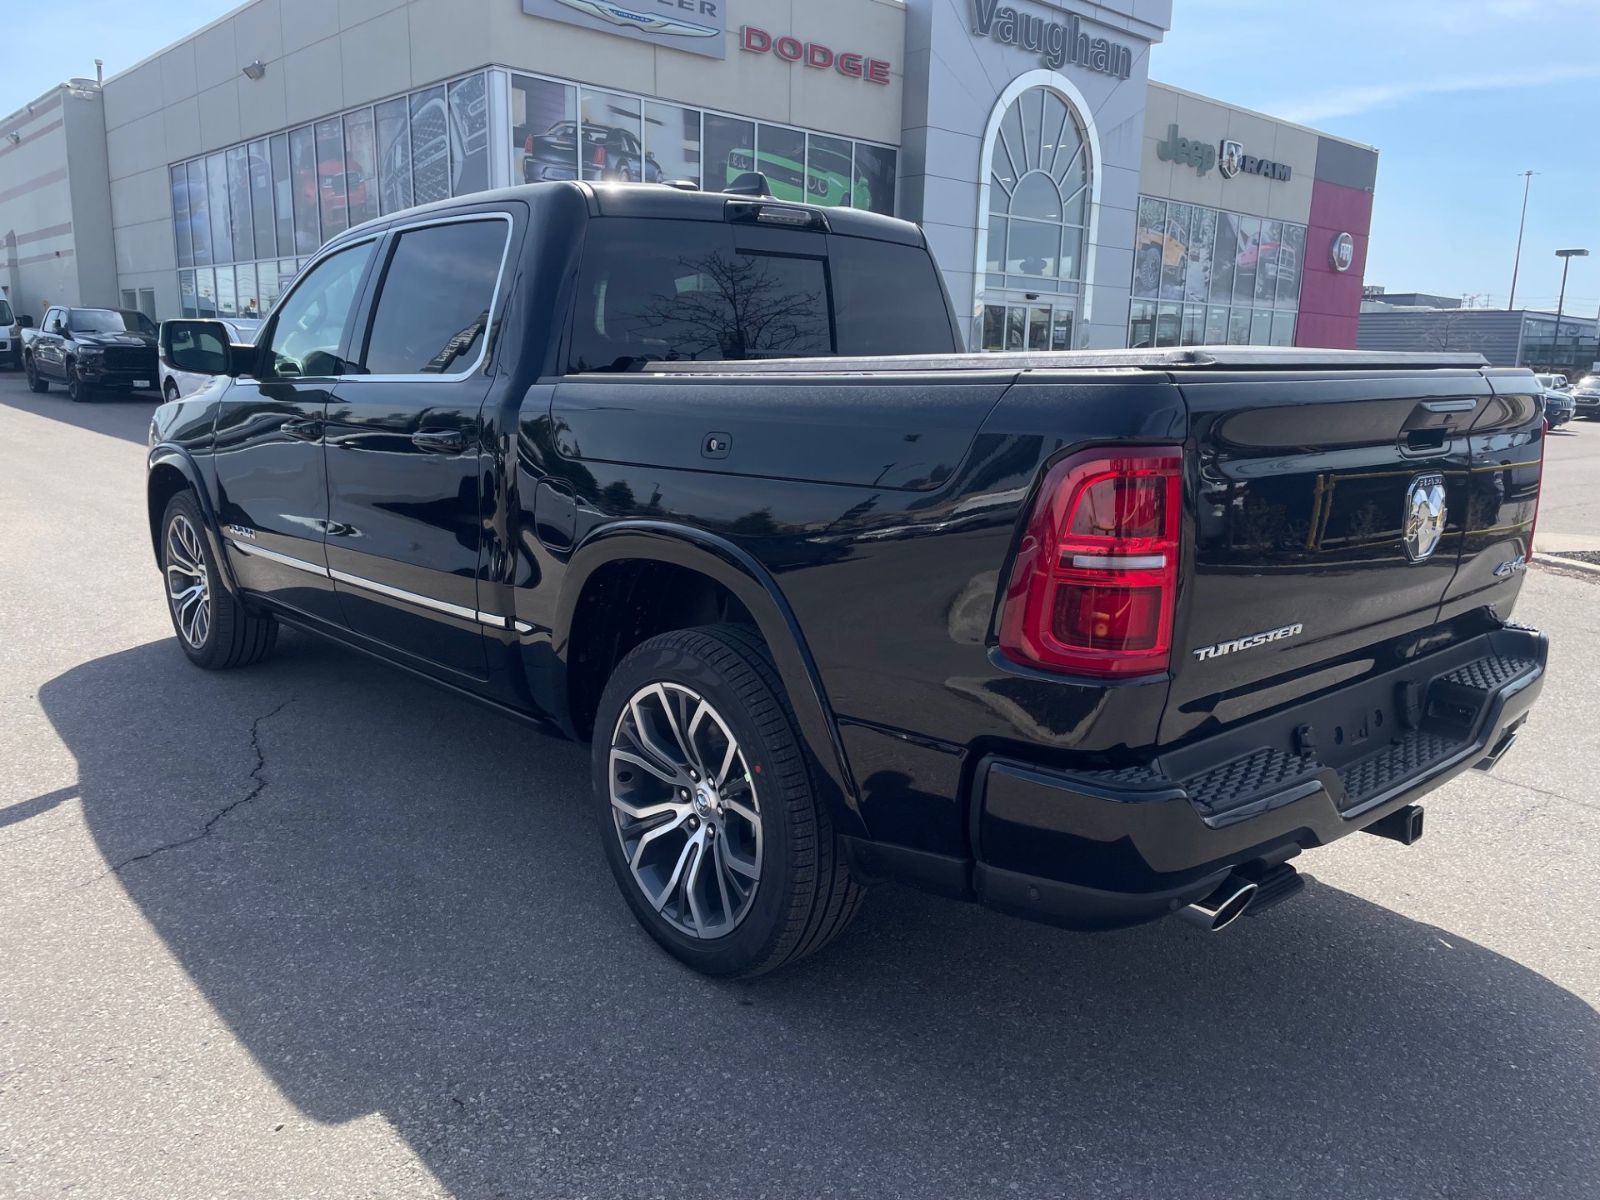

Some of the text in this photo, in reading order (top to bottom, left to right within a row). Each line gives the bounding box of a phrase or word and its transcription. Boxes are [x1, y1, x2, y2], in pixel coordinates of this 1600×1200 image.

[739, 25, 891, 85] DODGE
[974, 0, 1132, 79] Vaughan
[1156, 123, 1216, 177] Jeep
[1241, 154, 1292, 181] RAM
[1192, 621, 1303, 661] TUNGSTEN
